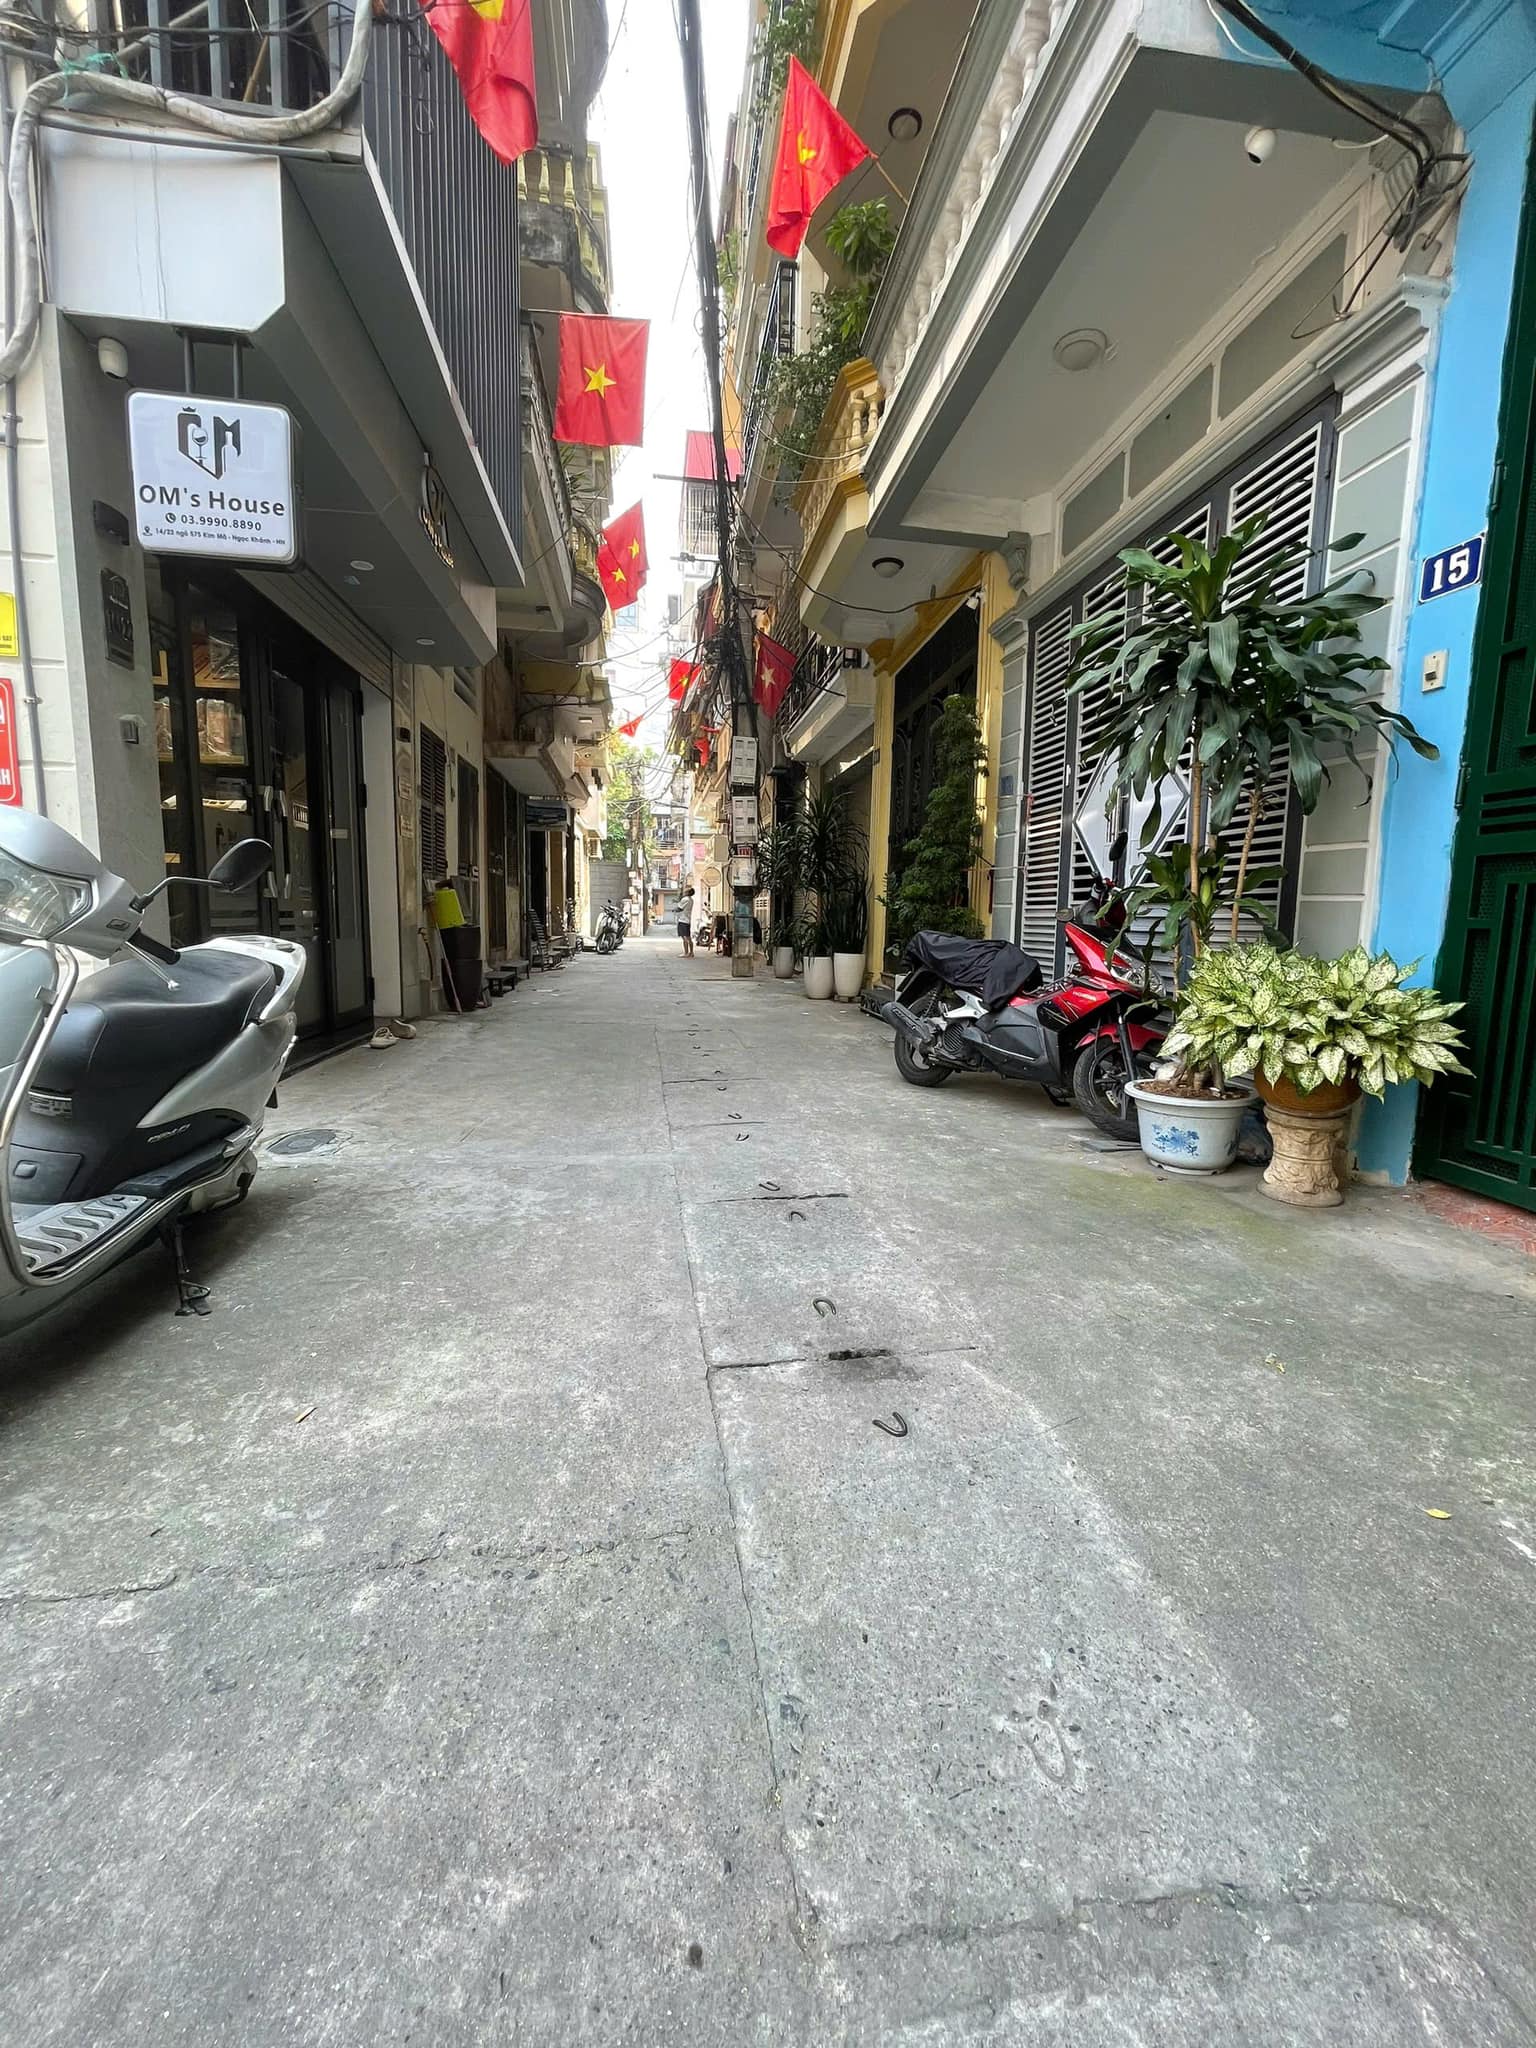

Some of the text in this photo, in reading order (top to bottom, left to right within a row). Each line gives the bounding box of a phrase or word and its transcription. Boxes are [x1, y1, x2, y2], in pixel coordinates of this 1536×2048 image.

[139, 484, 286, 516] OM's House
[180, 514, 263, 531] 03.9990.8890
[1430, 547, 1470, 593] 15
